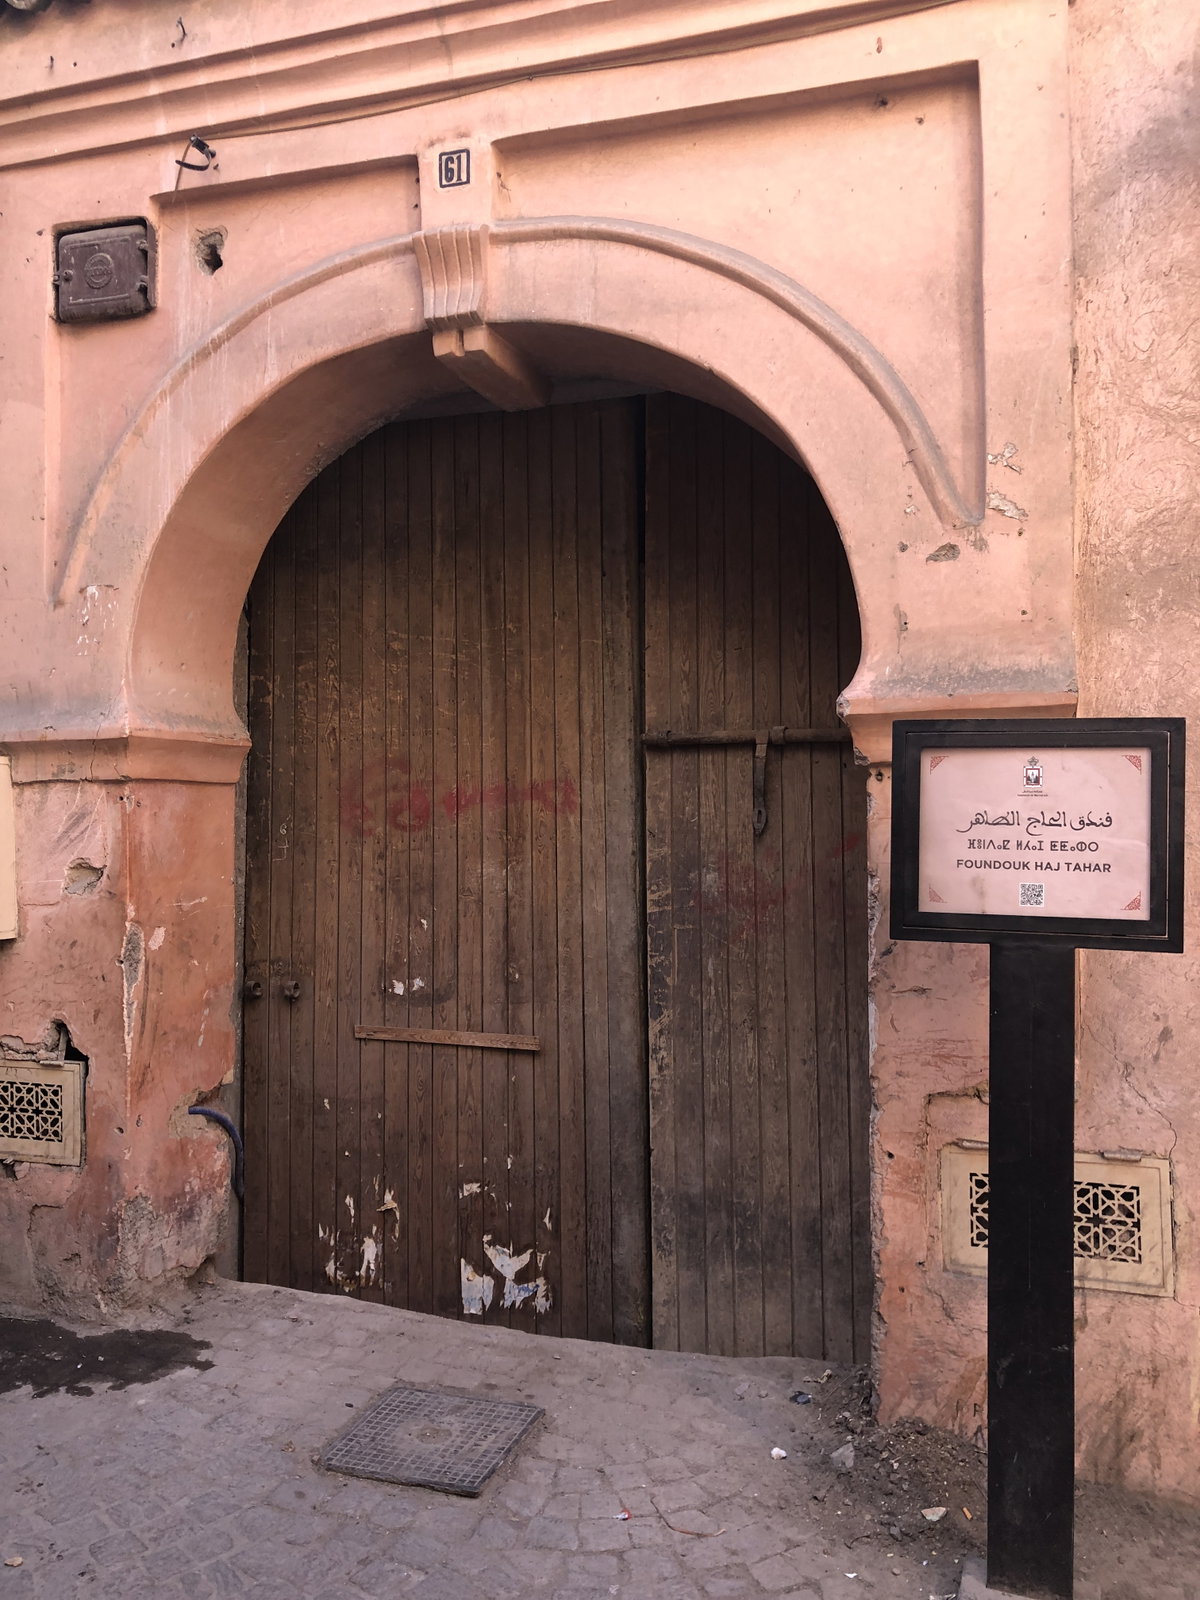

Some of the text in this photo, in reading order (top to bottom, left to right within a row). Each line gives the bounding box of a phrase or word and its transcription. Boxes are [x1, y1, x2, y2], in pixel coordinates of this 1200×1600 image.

[444, 153, 463, 183] 61
[1025, 810, 1067, 837] الحاج
[1069, 810, 1113, 831] فندق
[957, 859, 1112, 873] FOUNDOUK HAJ TAHAR
